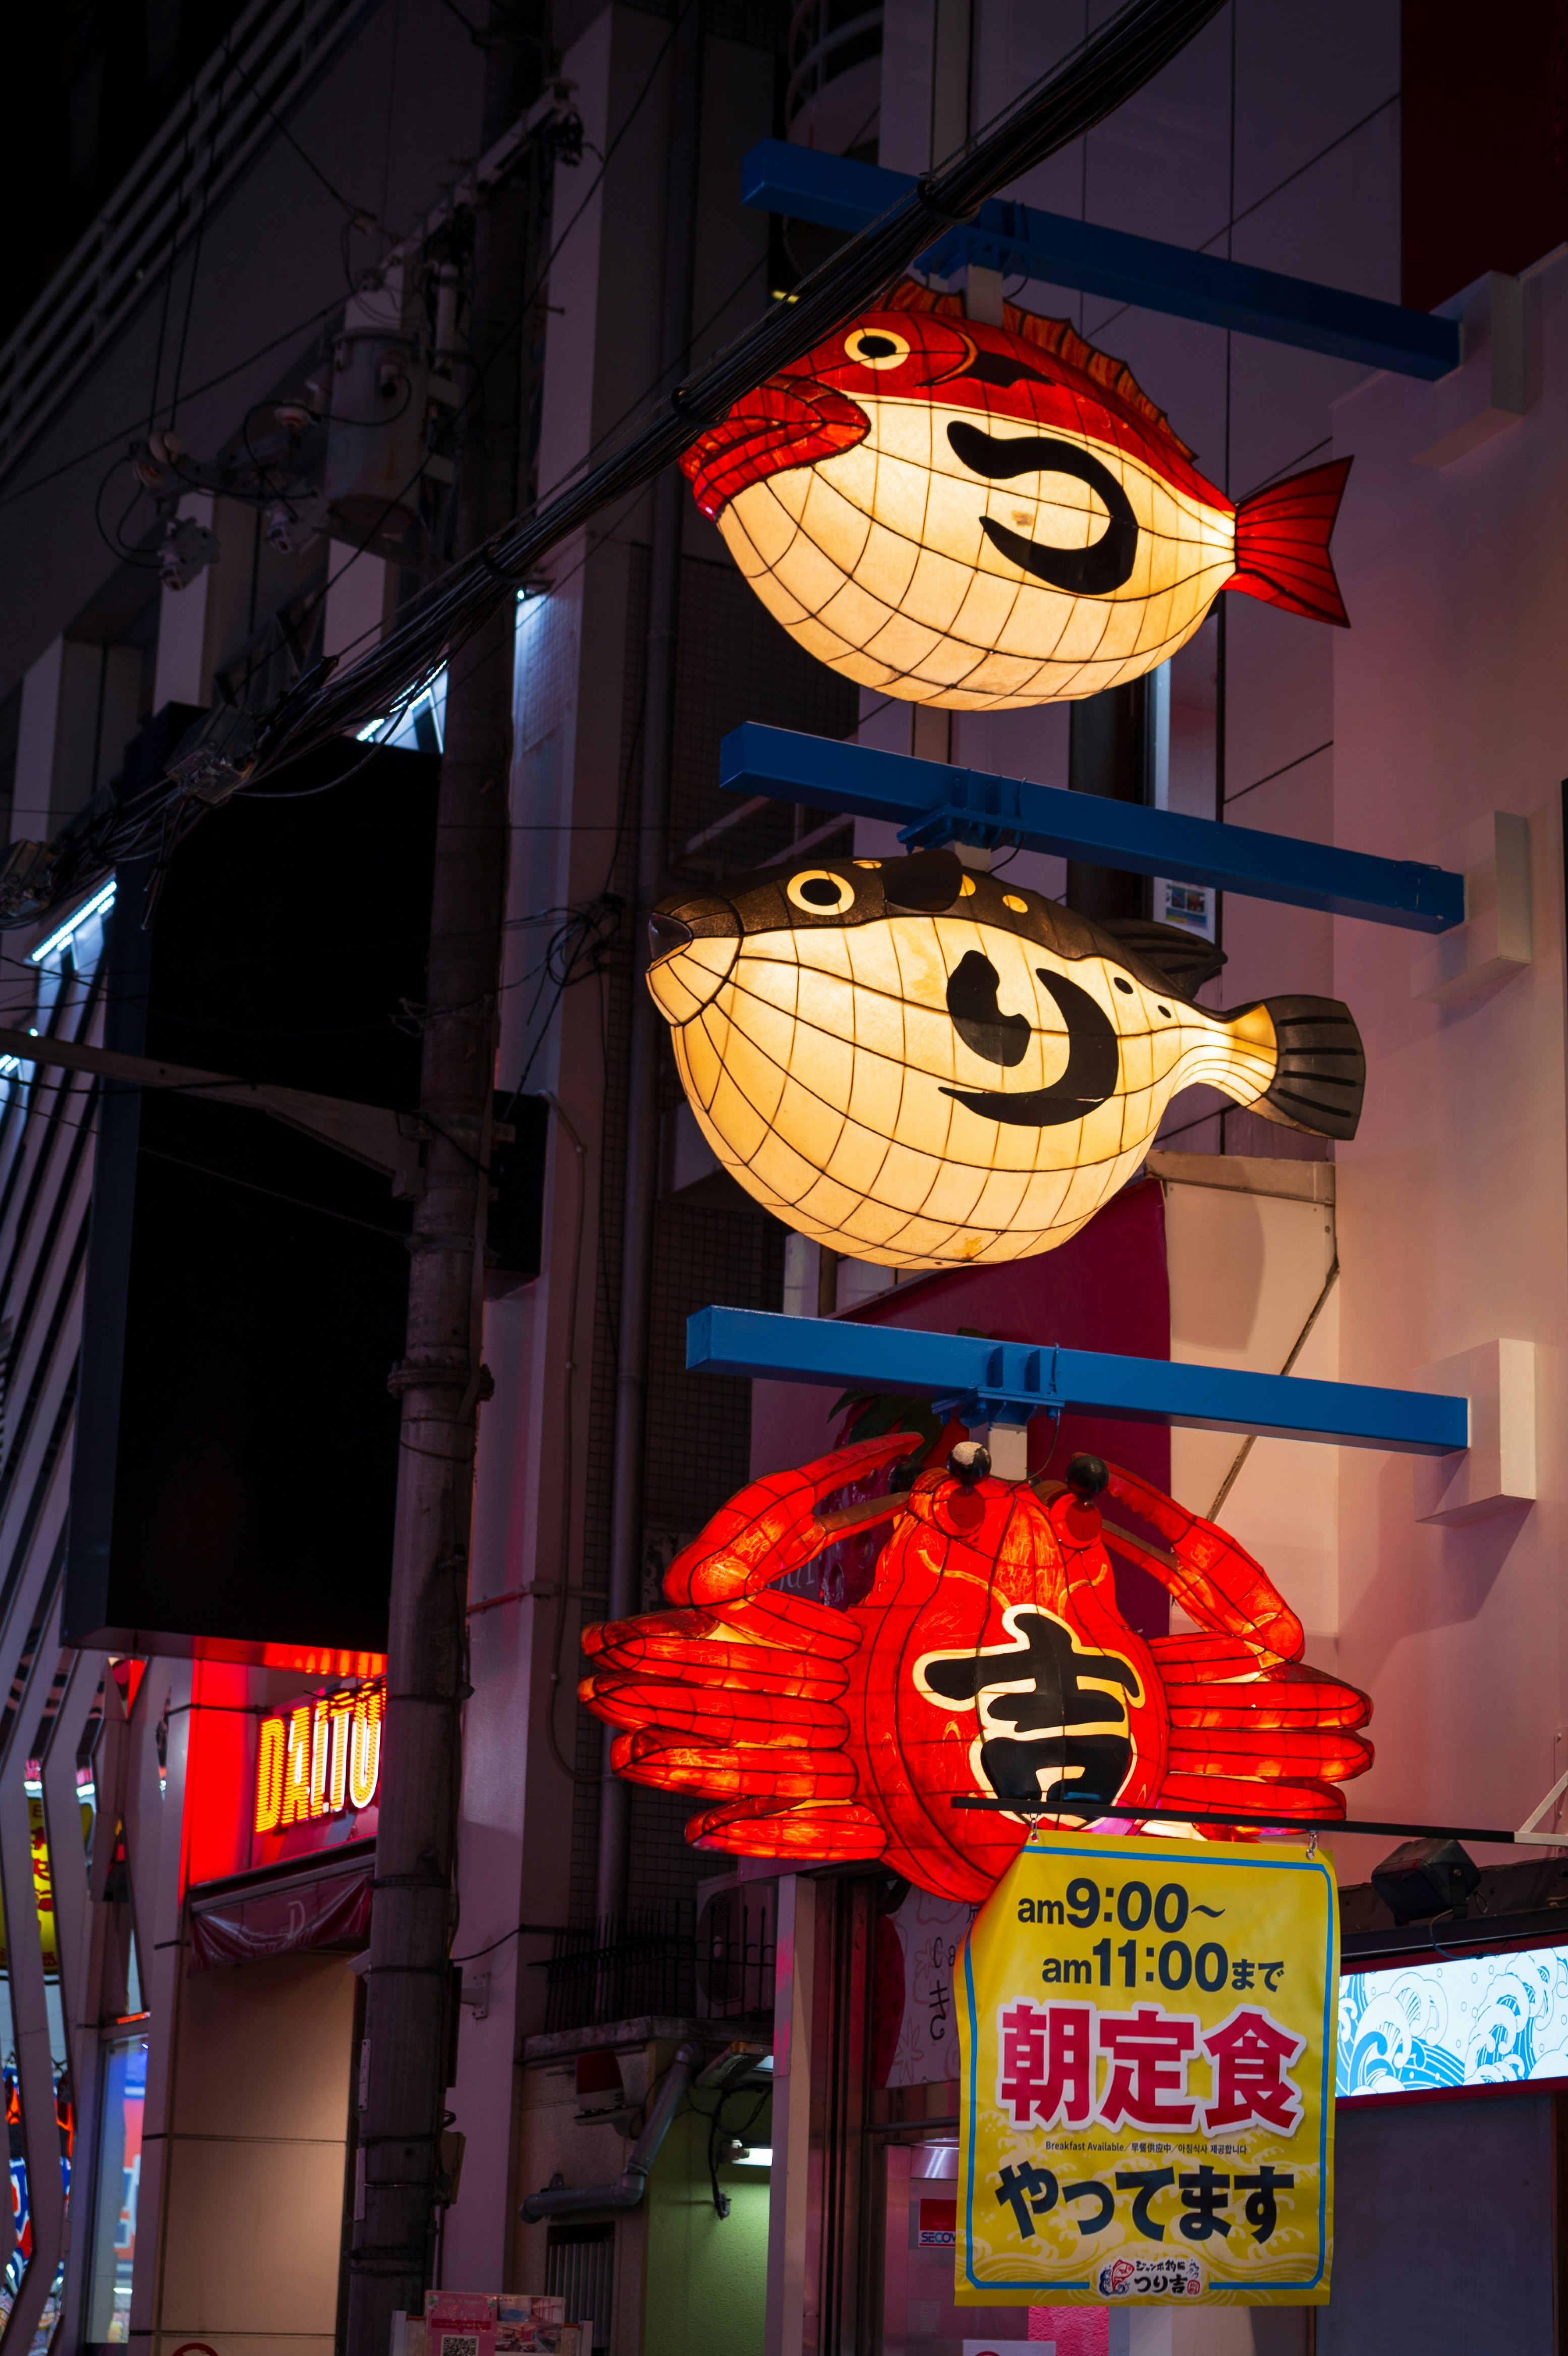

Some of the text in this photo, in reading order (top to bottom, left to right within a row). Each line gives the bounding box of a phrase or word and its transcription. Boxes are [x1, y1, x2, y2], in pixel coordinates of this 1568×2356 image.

[946, 420, 1139, 595] つ
[937, 949, 1119, 1128] り
[923, 1612, 1141, 1822] 吉
[1001, 2004, 1300, 2130] 朝定食
[995, 2161, 1295, 2245] やってます
[1046, 2141, 1085, 2151] Breakfast
[1134, 2274, 1188, 2294] つり吉
